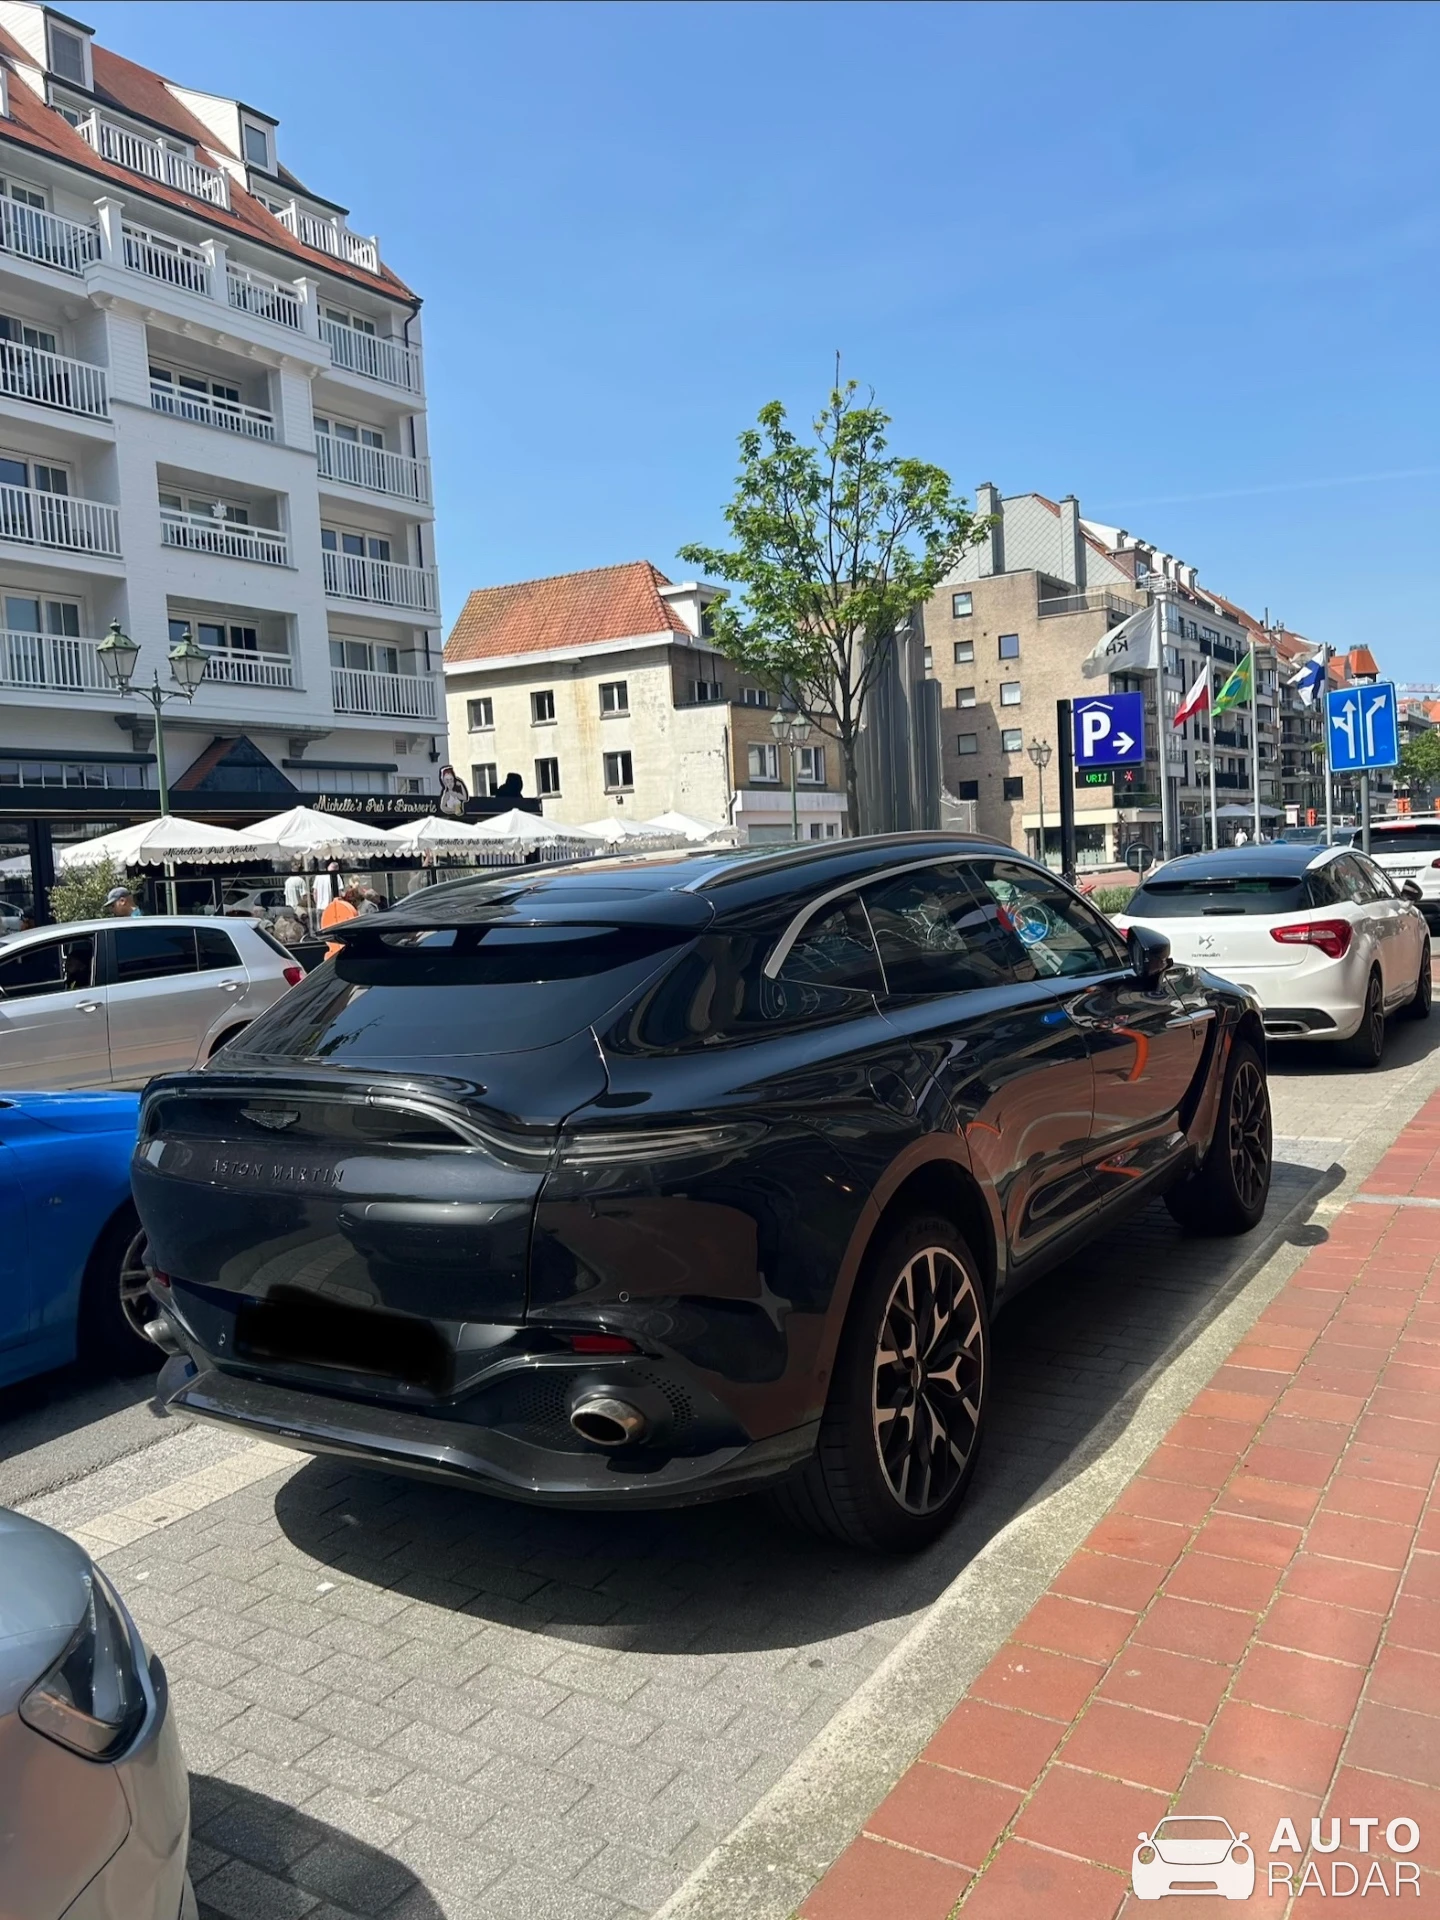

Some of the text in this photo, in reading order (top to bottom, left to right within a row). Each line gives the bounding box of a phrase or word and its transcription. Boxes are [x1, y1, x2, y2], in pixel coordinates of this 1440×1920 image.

[1082, 710, 1111, 758] P
[1085, 772, 1108, 783] VRIJ
[312, 794, 363, 812] Michelle's
[365, 798, 385, 813] Pub
[394, 798, 437, 813] Brasserie
[163, 845, 258, 857] Michelle's Pub Knokke
[212, 1159, 345, 1184] ASTON MARTIN
